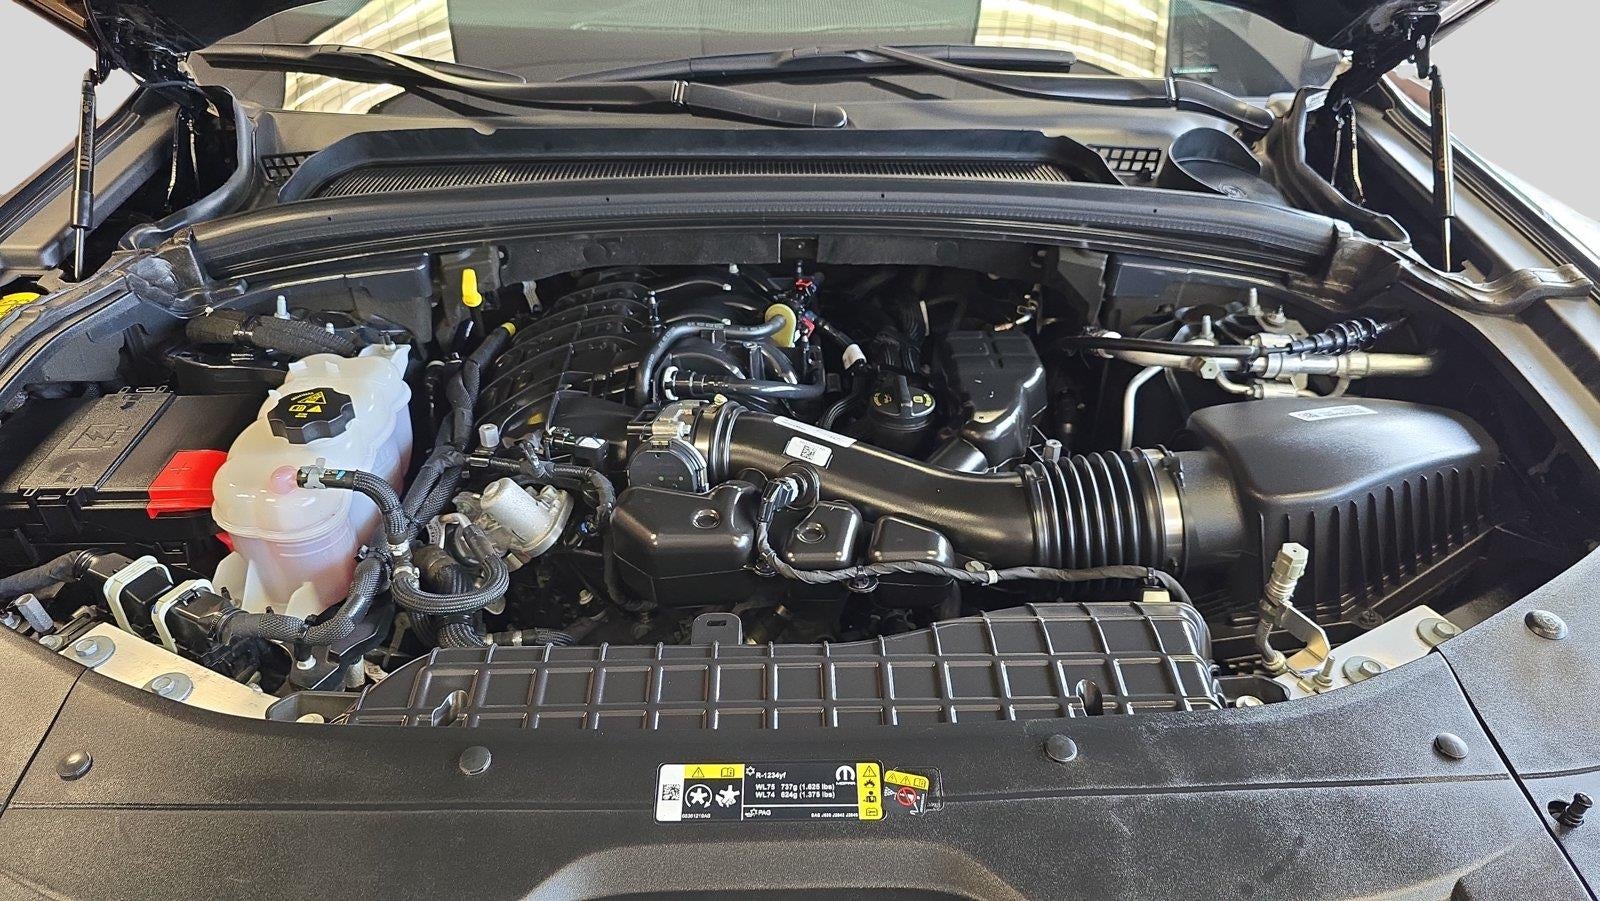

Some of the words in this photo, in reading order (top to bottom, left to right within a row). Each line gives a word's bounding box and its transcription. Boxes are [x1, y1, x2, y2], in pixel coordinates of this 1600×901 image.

[755, 771, 787, 780] R-1234yf
[755, 783, 776, 791] WL75
[780, 783, 798, 792] 737g
[799, 783, 820, 791] (1.625
[821, 783, 835, 791] lbs)
[755, 791, 776, 799] WL74
[821, 791, 836, 799] lbs)
